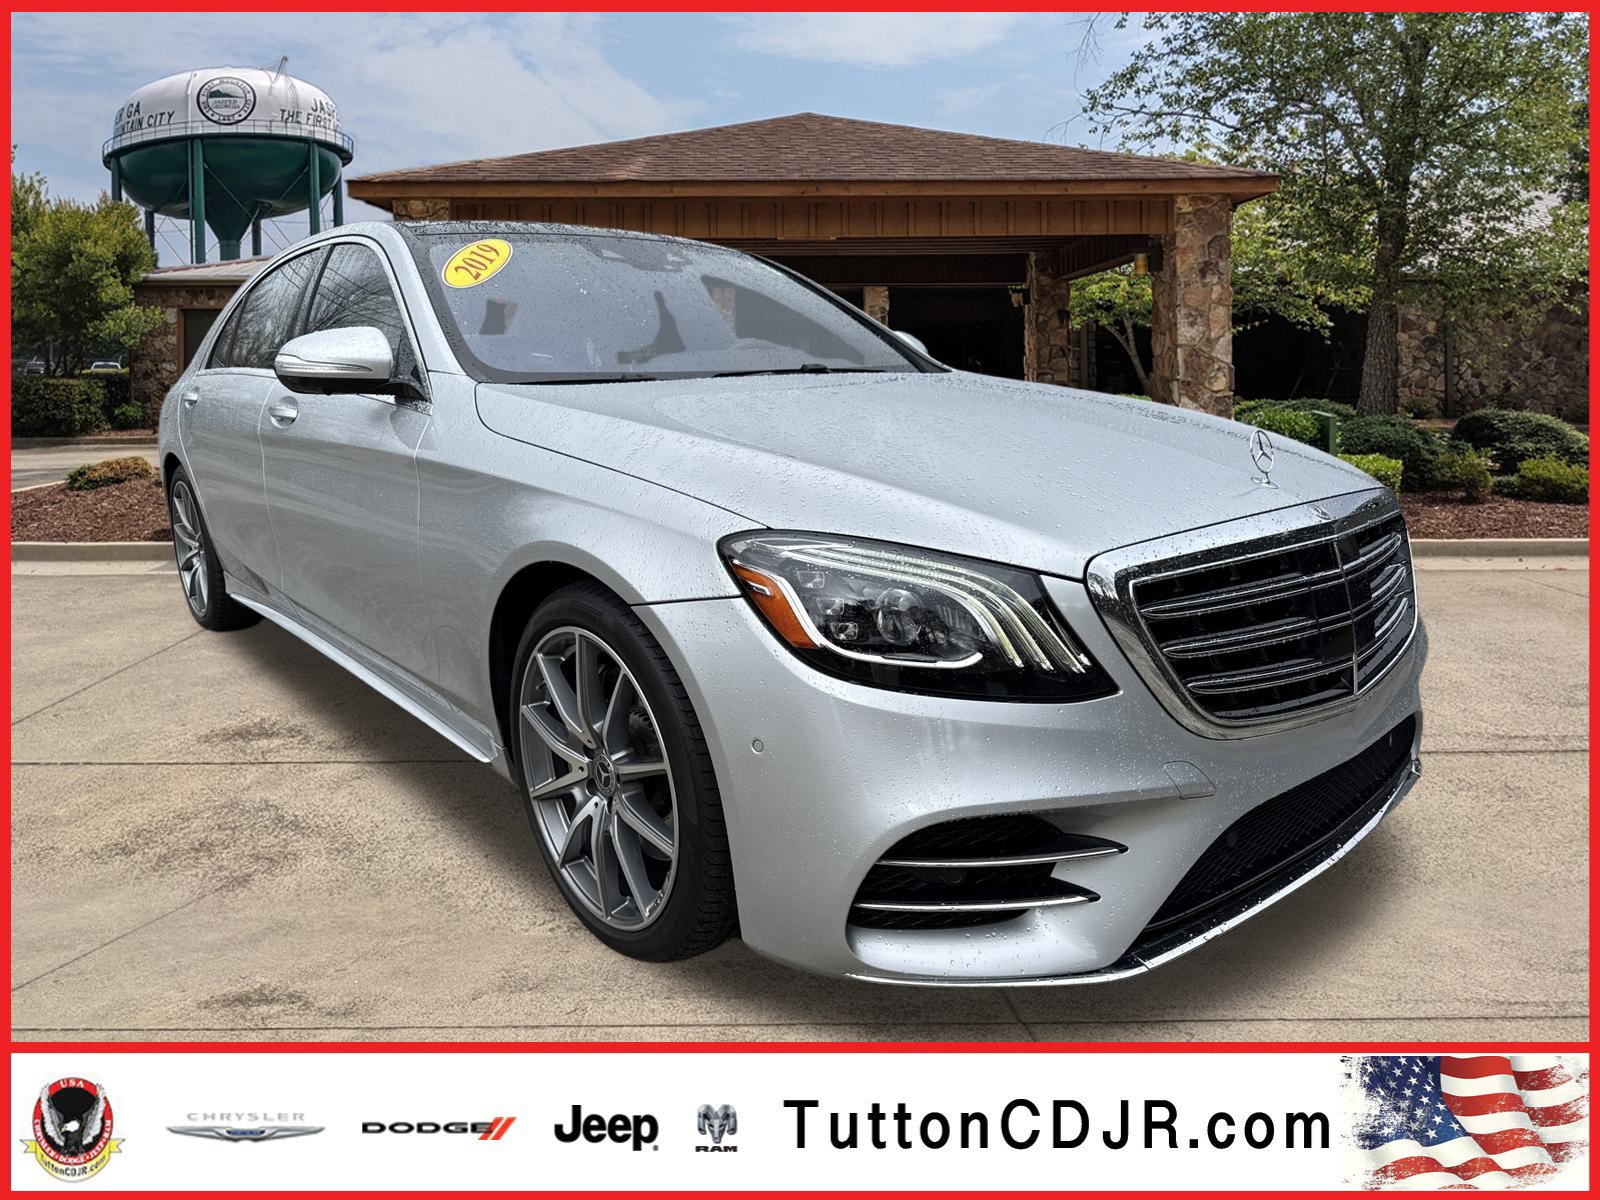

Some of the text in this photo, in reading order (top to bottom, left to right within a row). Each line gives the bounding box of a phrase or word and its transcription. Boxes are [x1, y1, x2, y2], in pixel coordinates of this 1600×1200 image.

[127, 100, 141, 119] GA
[147, 110, 175, 127] CITY
[280, 108, 302, 124] THE
[454, 243, 500, 281] 2019
